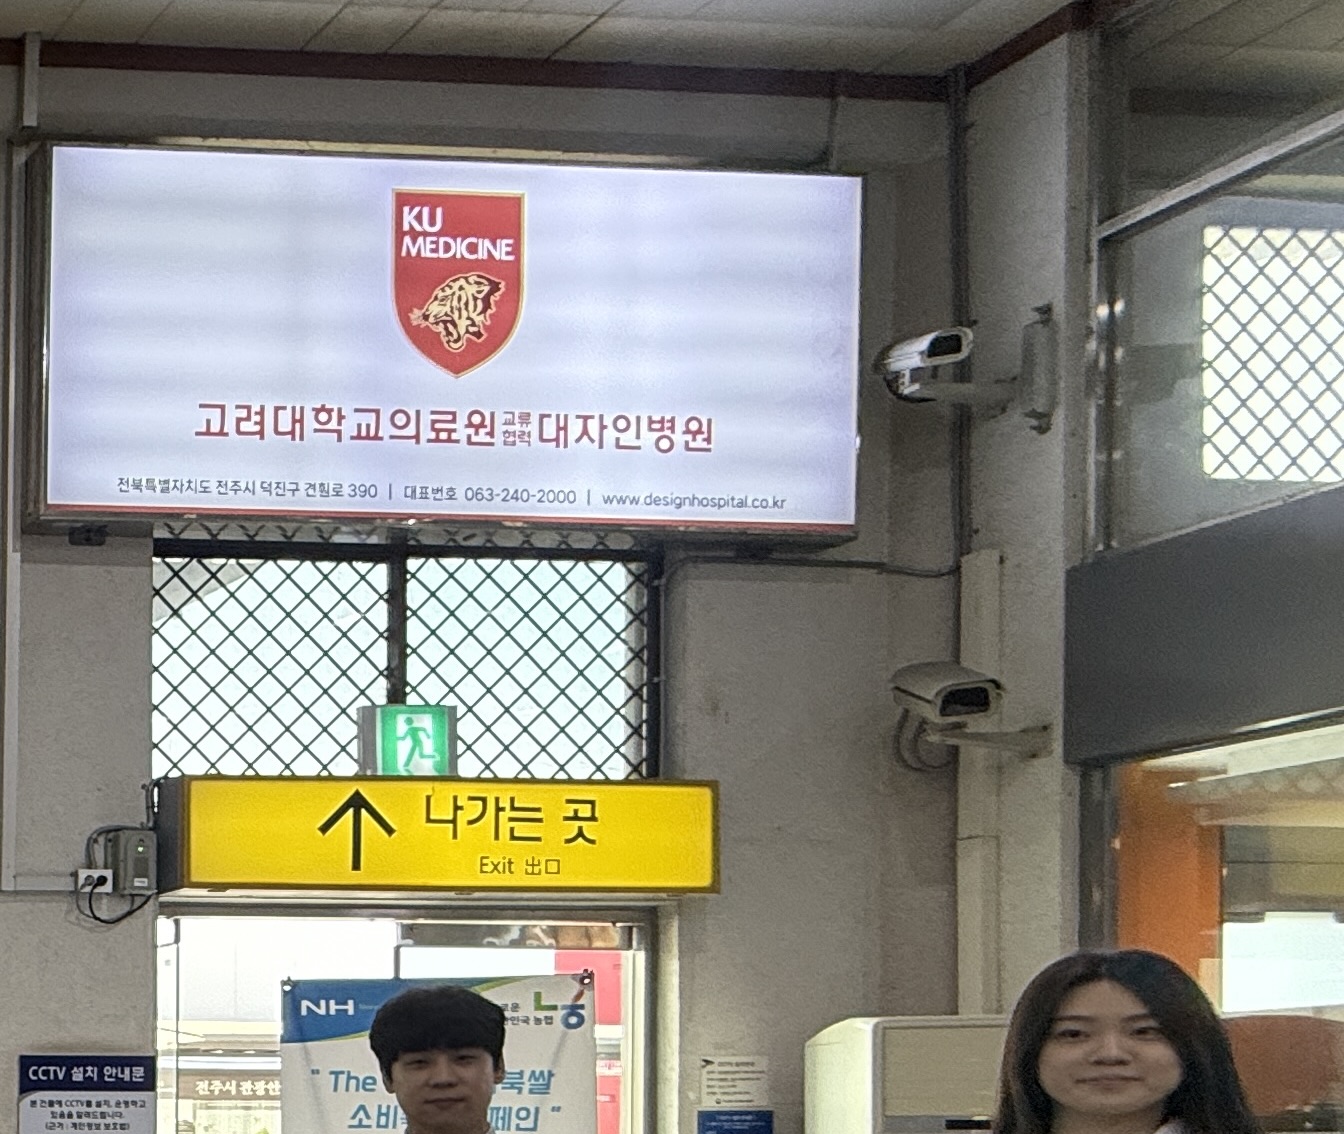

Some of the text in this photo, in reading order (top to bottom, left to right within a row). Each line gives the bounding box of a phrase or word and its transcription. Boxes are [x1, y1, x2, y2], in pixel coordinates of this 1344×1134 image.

[401, 206, 443, 232] KU
[401, 235, 516, 262] MEDICINE
[193, 403, 498, 449] 고려대학교의료원
[502, 411, 532, 428] 교류
[502, 429, 532, 448] 협력
[538, 412, 715, 454] 대자인병원
[116, 476, 212, 497] 전북특별자치도
[215, 479, 257, 498] 전주시
[260, 480, 300, 499] 덕진구
[347, 483, 378, 499] 390
[403, 484, 458, 502] 대표번호
[464, 488, 577, 504] 063-240-2000
[602, 491, 786, 511] www.designhospital.co.kr
[424, 795, 600, 847] 나가는 곳
[479, 855, 562, 877] Exit 出口
[300, 999, 354, 1016] NH
[28, 1066, 145, 1082] CCTV 설치 안내문
[328, 1069, 555, 1095] The 북쌀
[195, 1080, 237, 1096] 전주시
[347, 1104, 539, 1132] 소비 페인
